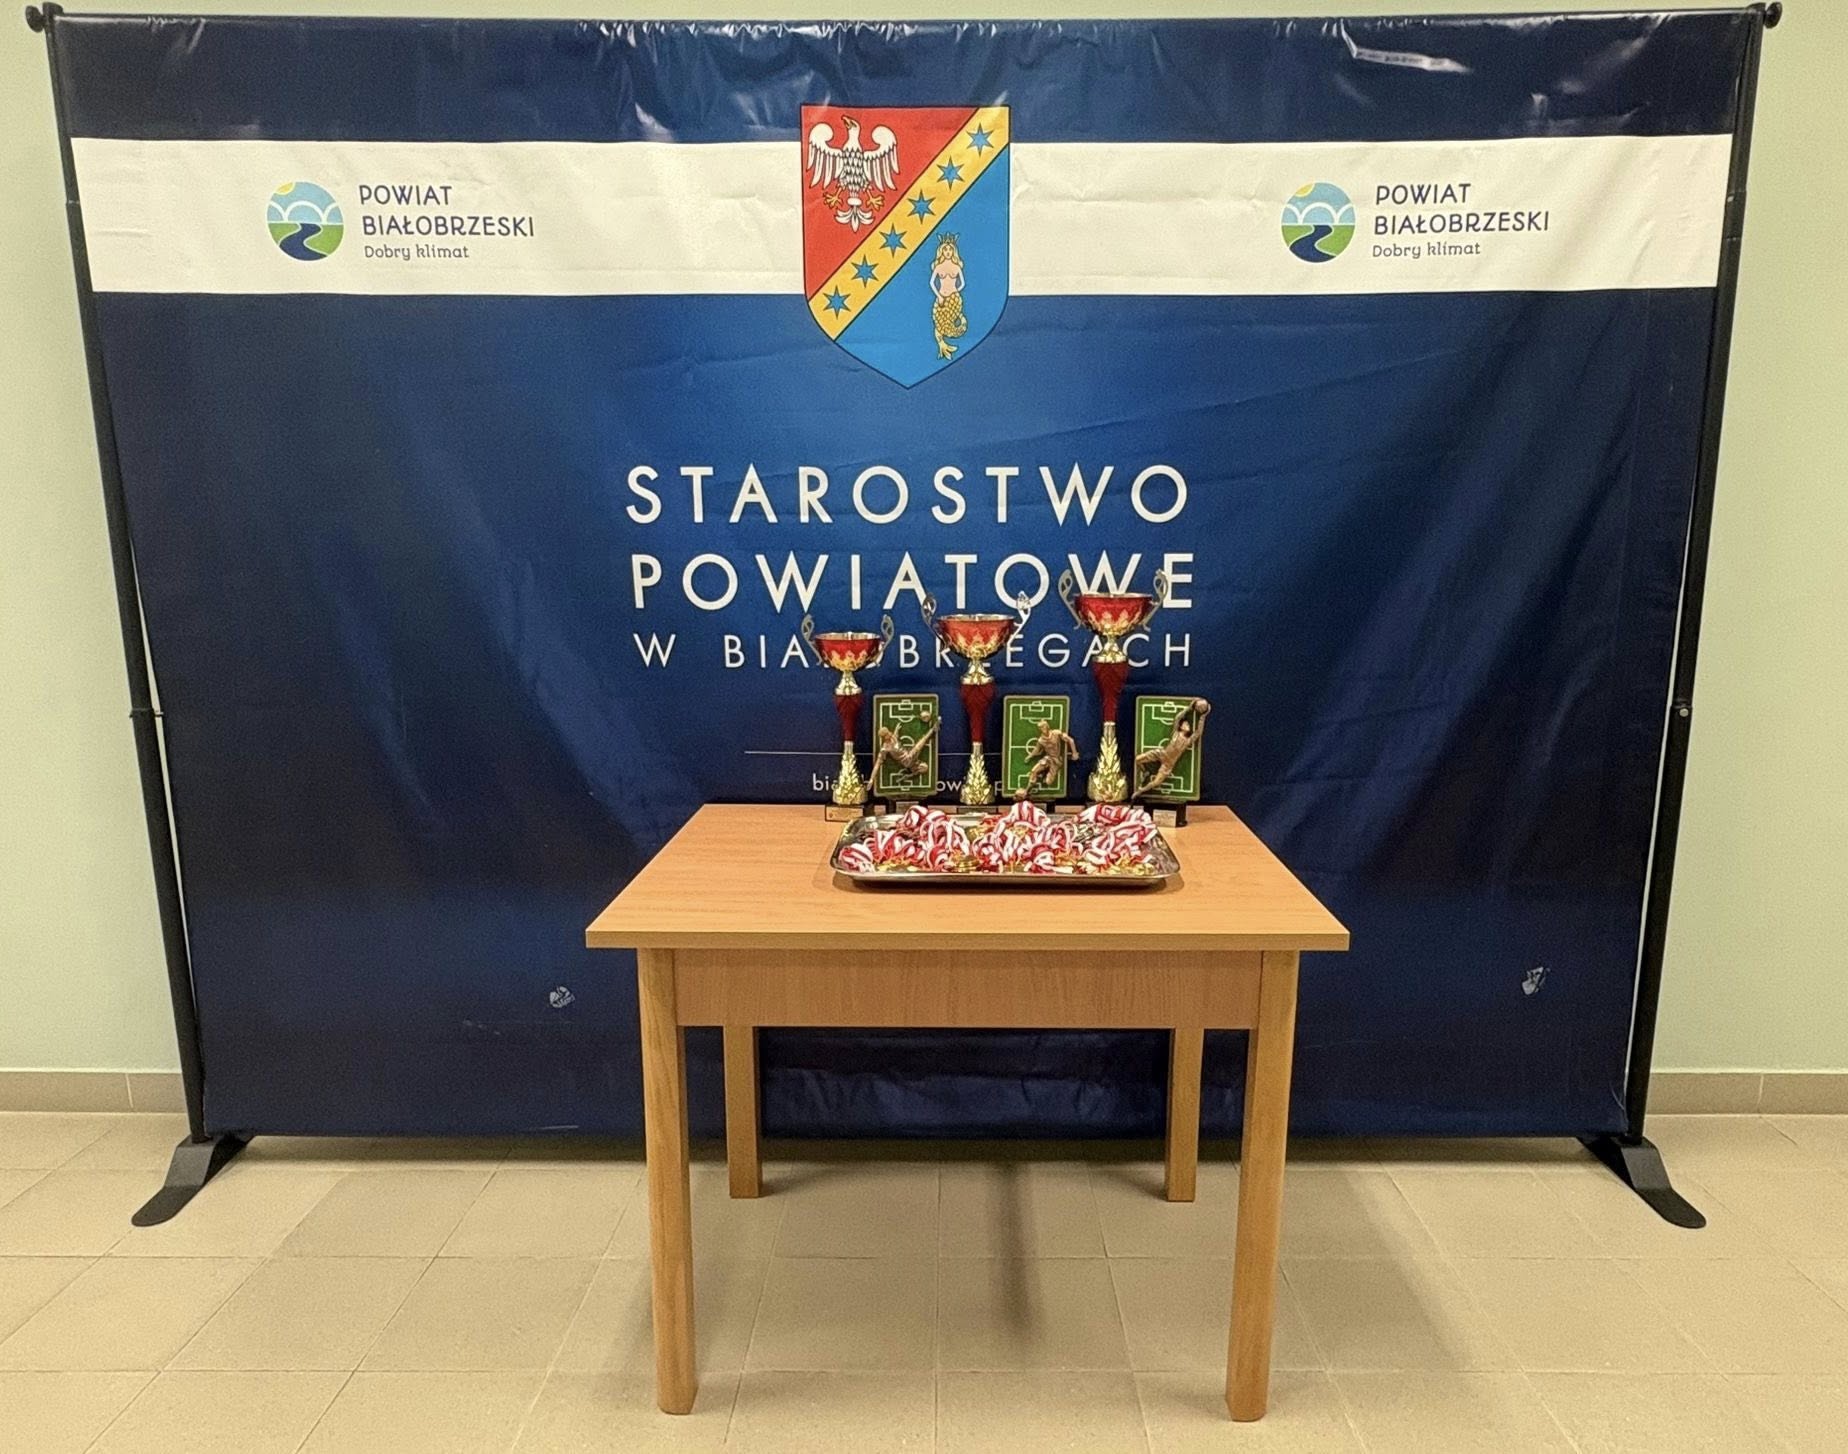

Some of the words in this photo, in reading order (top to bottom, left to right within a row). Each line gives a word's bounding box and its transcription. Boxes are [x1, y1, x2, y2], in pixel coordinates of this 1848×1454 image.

[359, 185, 452, 205] POWIAT
[1376, 183, 1471, 205] POWIAT
[362, 215, 534, 237] BIAŁOBRZESKI
[1374, 211, 1549, 235] BIAŁOBRZESKI
[364, 245, 411, 261] Dobry
[416, 244, 469, 258] klimat
[1372, 244, 1421, 259] Dobry
[1427, 242, 1480, 256] klimat
[626, 462, 1188, 527] STAROSTWO
[631, 550, 1194, 613] POWIATOWE
[633, 632, 676, 667] W
